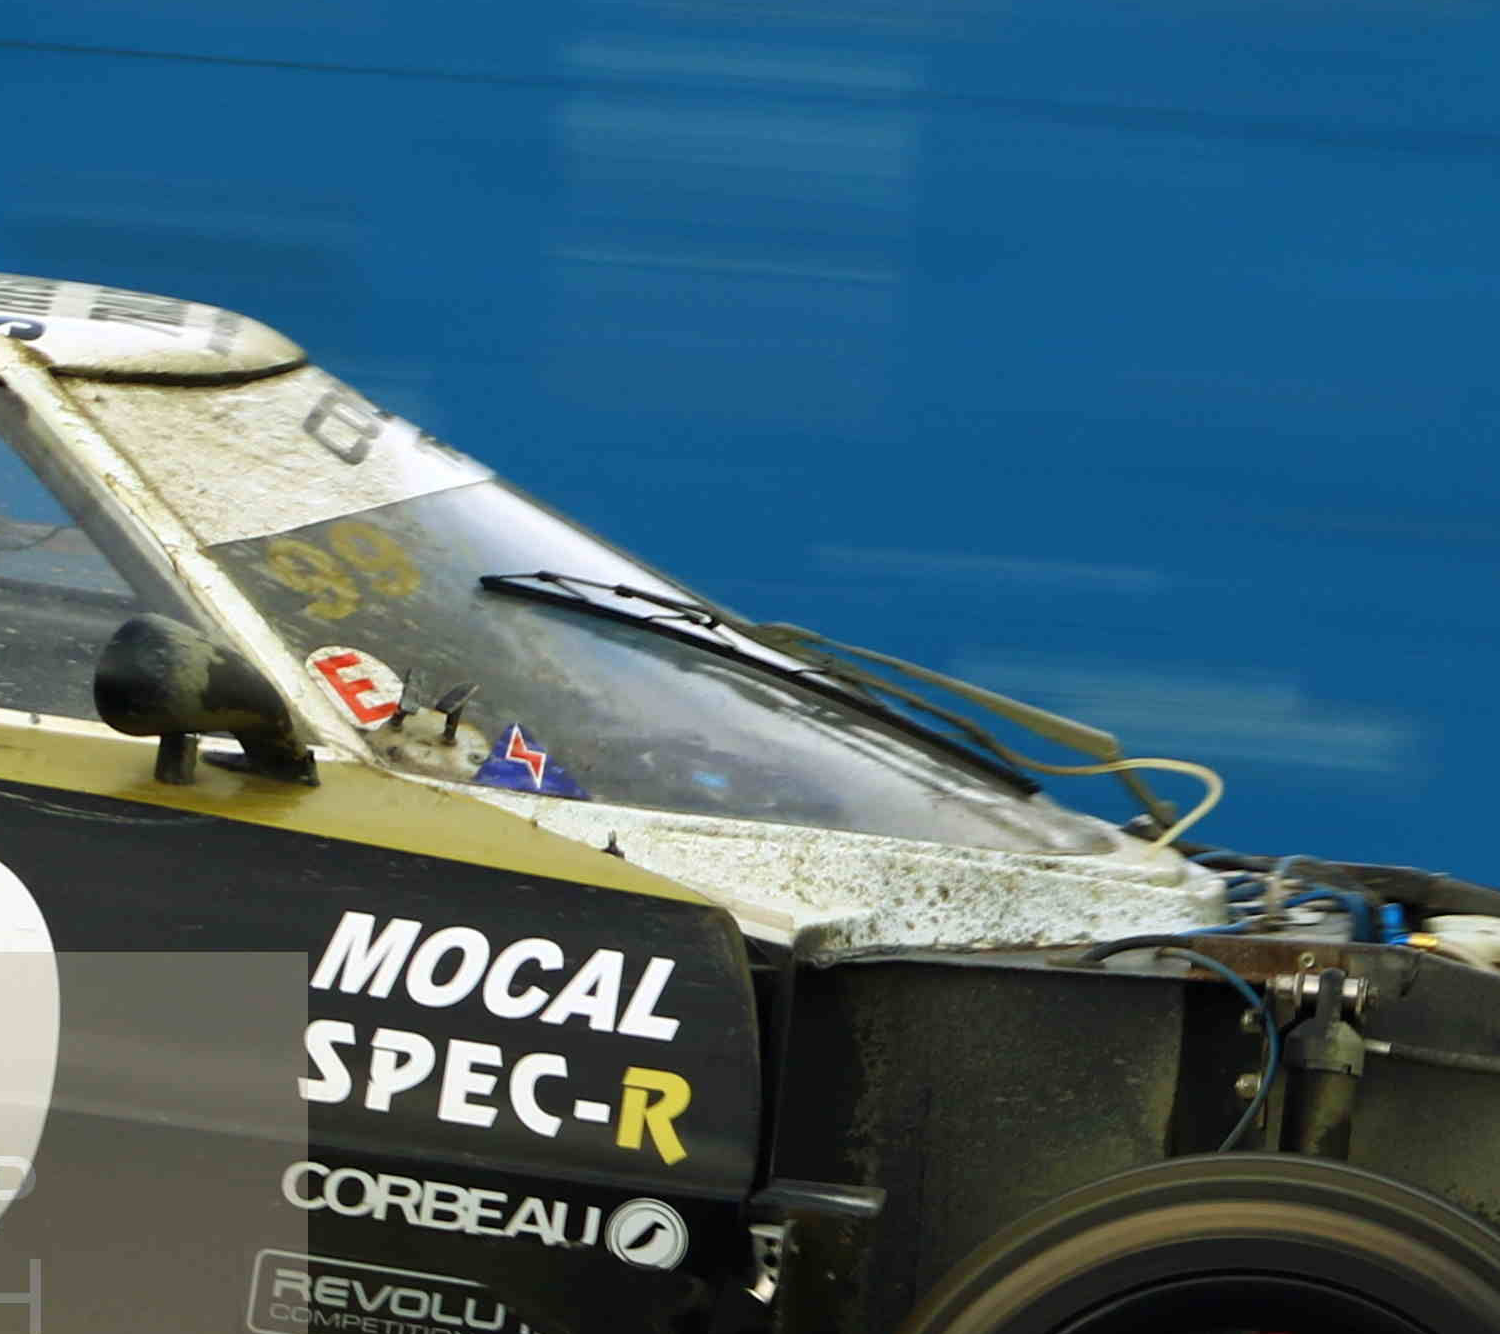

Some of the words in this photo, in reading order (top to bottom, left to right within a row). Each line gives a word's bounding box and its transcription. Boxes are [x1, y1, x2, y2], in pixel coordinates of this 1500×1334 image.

[310, 910, 681, 1042] MOCAL
[297, 1018, 692, 1166] SPEC-R
[281, 1160, 602, 1248] CORBEAU
